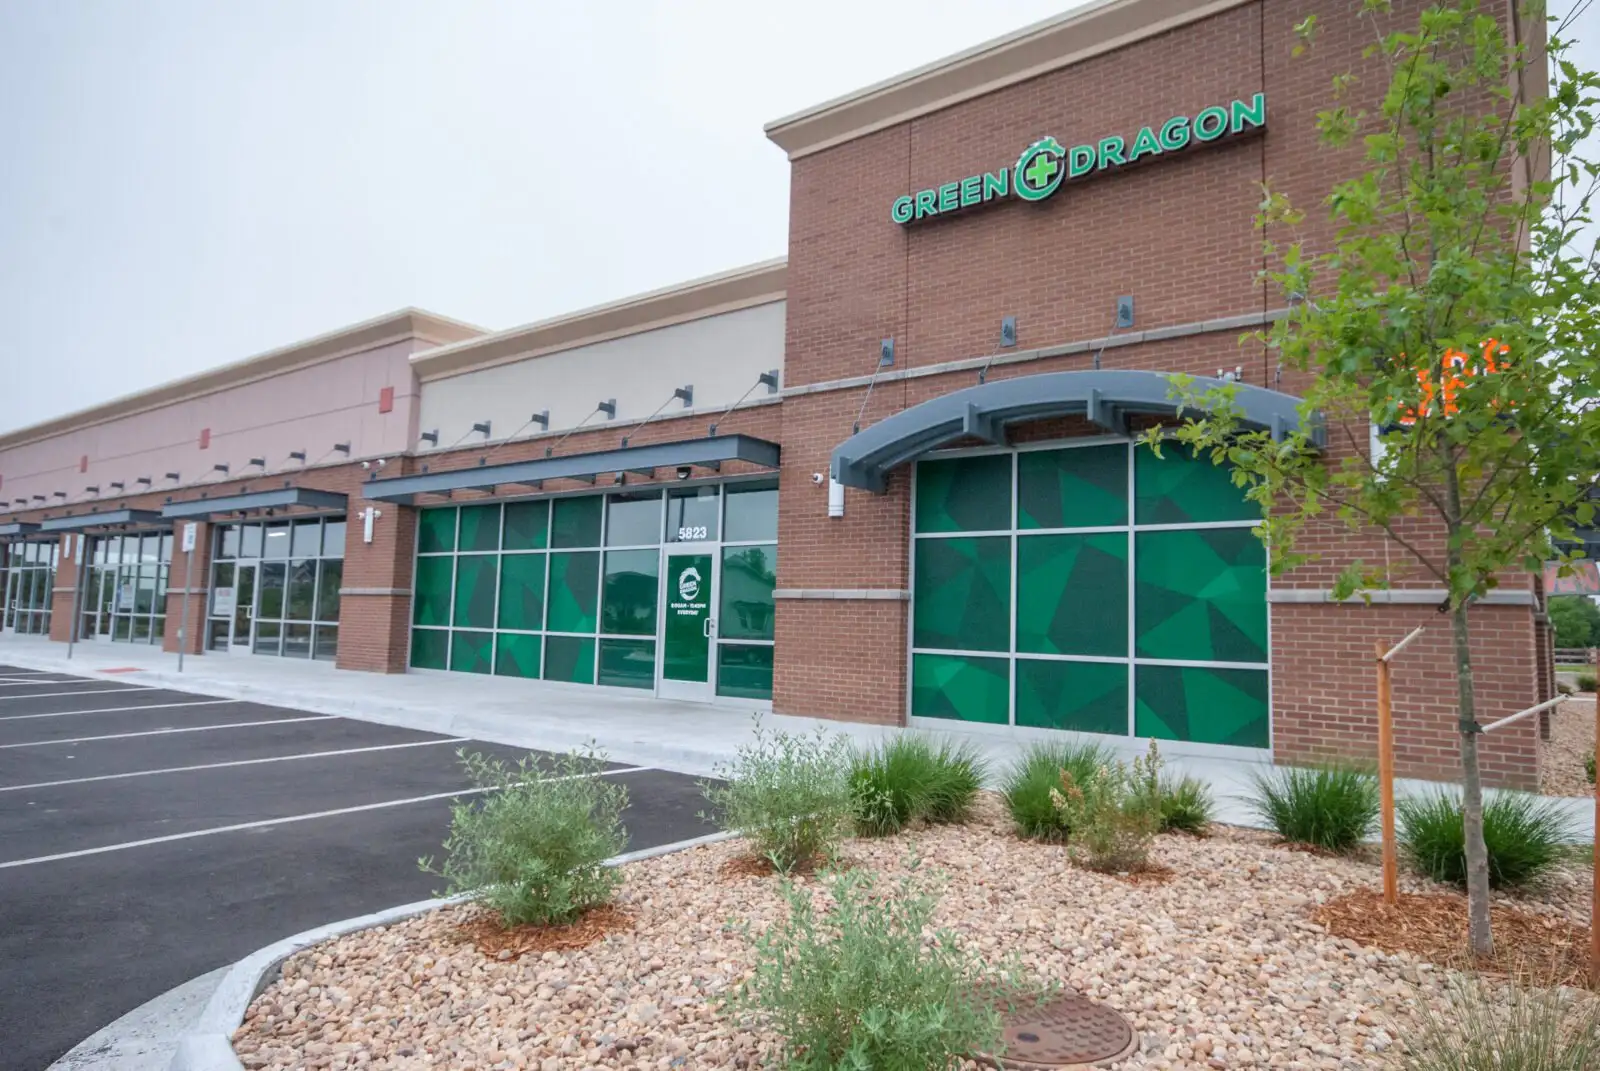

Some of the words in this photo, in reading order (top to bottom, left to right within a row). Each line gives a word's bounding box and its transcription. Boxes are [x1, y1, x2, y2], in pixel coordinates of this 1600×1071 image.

[891, 168, 1009, 224] GREEN
[1069, 92, 1266, 178] DRAGON
[679, 526, 707, 539] 5823
